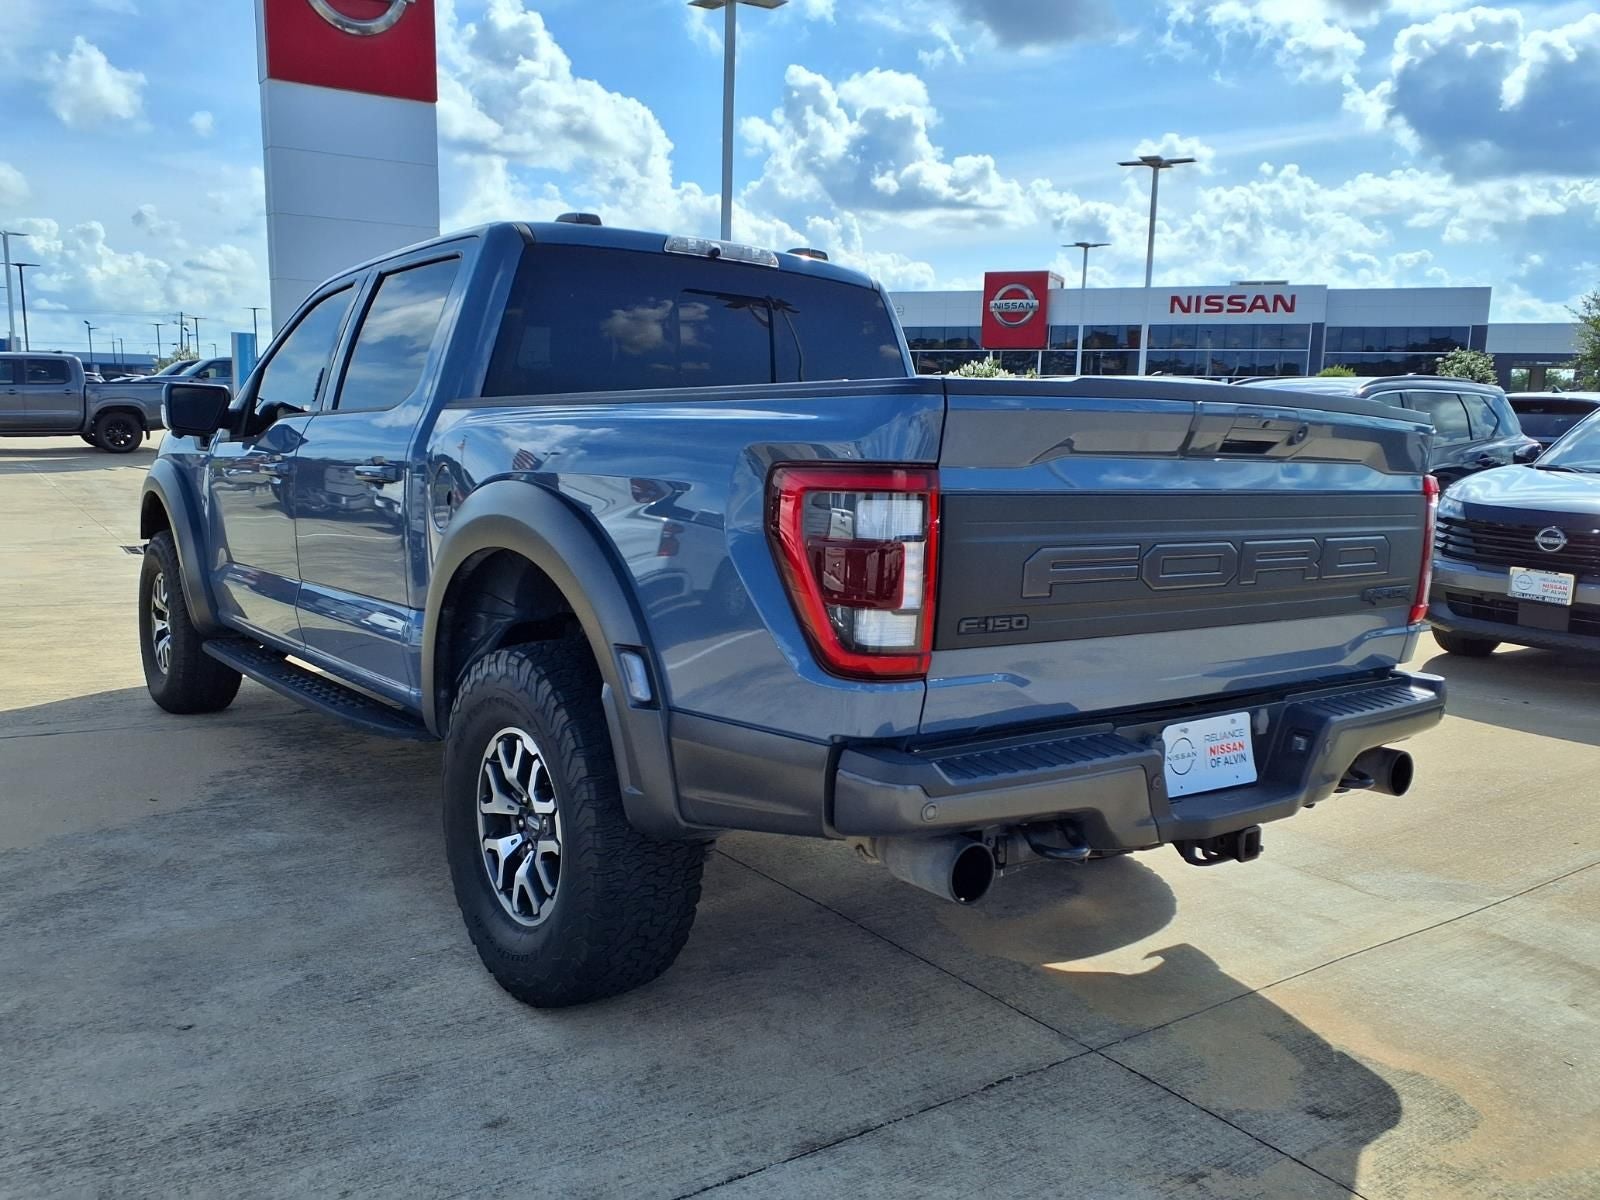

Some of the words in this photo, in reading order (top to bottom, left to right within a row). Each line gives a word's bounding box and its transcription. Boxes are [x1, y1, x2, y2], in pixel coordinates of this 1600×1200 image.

[994, 302, 1034, 310] NISSAN
[1169, 294, 1296, 313] NISSAN
[1022, 535, 1391, 598] FORD
[957, 614, 1029, 635] F-150
[1204, 728, 1245, 742] RELIANCE
[1210, 742, 1245, 756] NISSAN
[1210, 758, 1222, 768] OF
[1223, 753, 1247, 765] ALVIN
